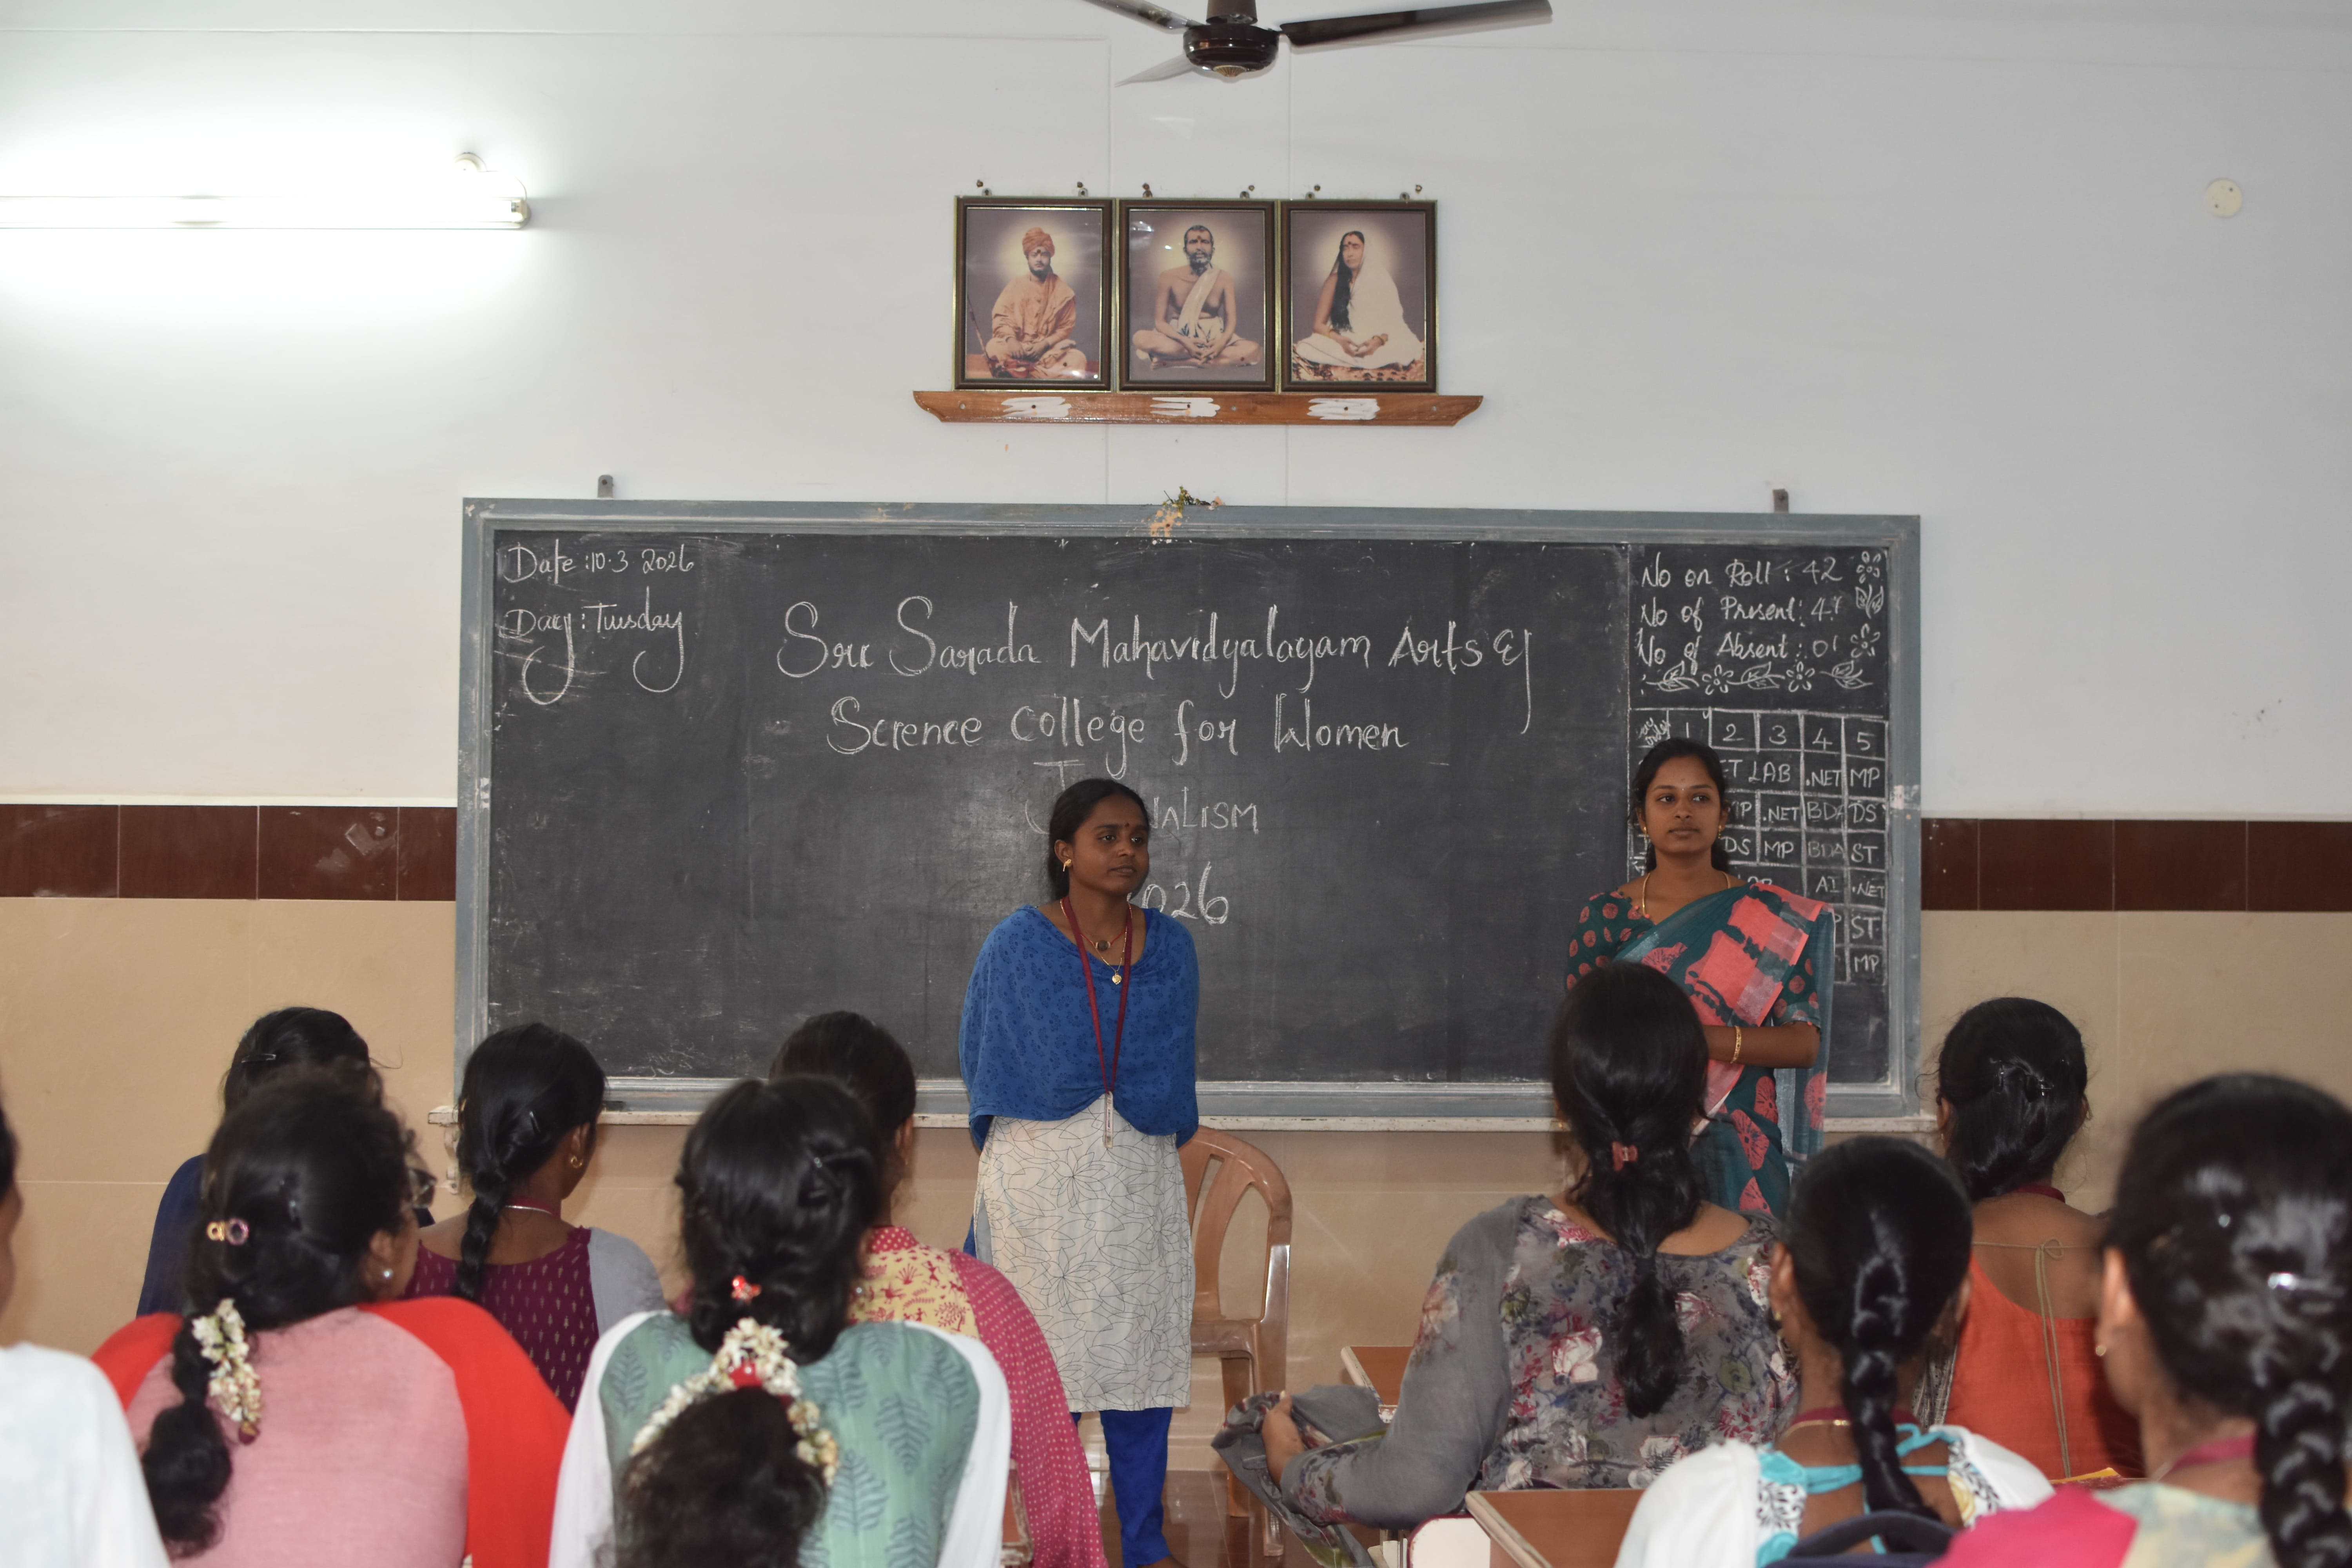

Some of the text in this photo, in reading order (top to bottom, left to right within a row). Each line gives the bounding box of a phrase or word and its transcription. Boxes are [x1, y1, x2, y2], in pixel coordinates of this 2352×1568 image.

[503, 539, 577, 584] Date
[1641, 552, 1670, 588] No
[1685, 569, 1712, 587] on
[1725, 558, 1770, 588] Roll
[1802, 556, 1843, 584] 42
[1641, 596, 1668, 627] No
[1681, 596, 1704, 632] of
[499, 609, 575, 705] Day
[777, 595, 1533, 735] Sri Sarada Mahavidyalayam Arts &
[1638, 635, 1666, 667] No
[1683, 635, 1702, 676] of
[826, 696, 983, 755] Science
[1171, 699, 1239, 766] for
[1274, 693, 1410, 753] Women
[1722, 723, 1744, 742] 2
[1769, 724, 1787, 745] 3
[1812, 728, 1833, 753] 4
[1857, 731, 1876, 751] 5
[1748, 761, 1791, 783] LAB
[1850, 767, 1880, 788] MP
[1847, 802, 1877, 824] DS
[1721, 836, 1751, 856] DS
[1764, 840, 1794, 859] MP
[1850, 843, 1878, 864] ST
[1127, 861, 1229, 925] 026
[1851, 915, 1880, 940] ST
[1854, 953, 1879, 973] MP
